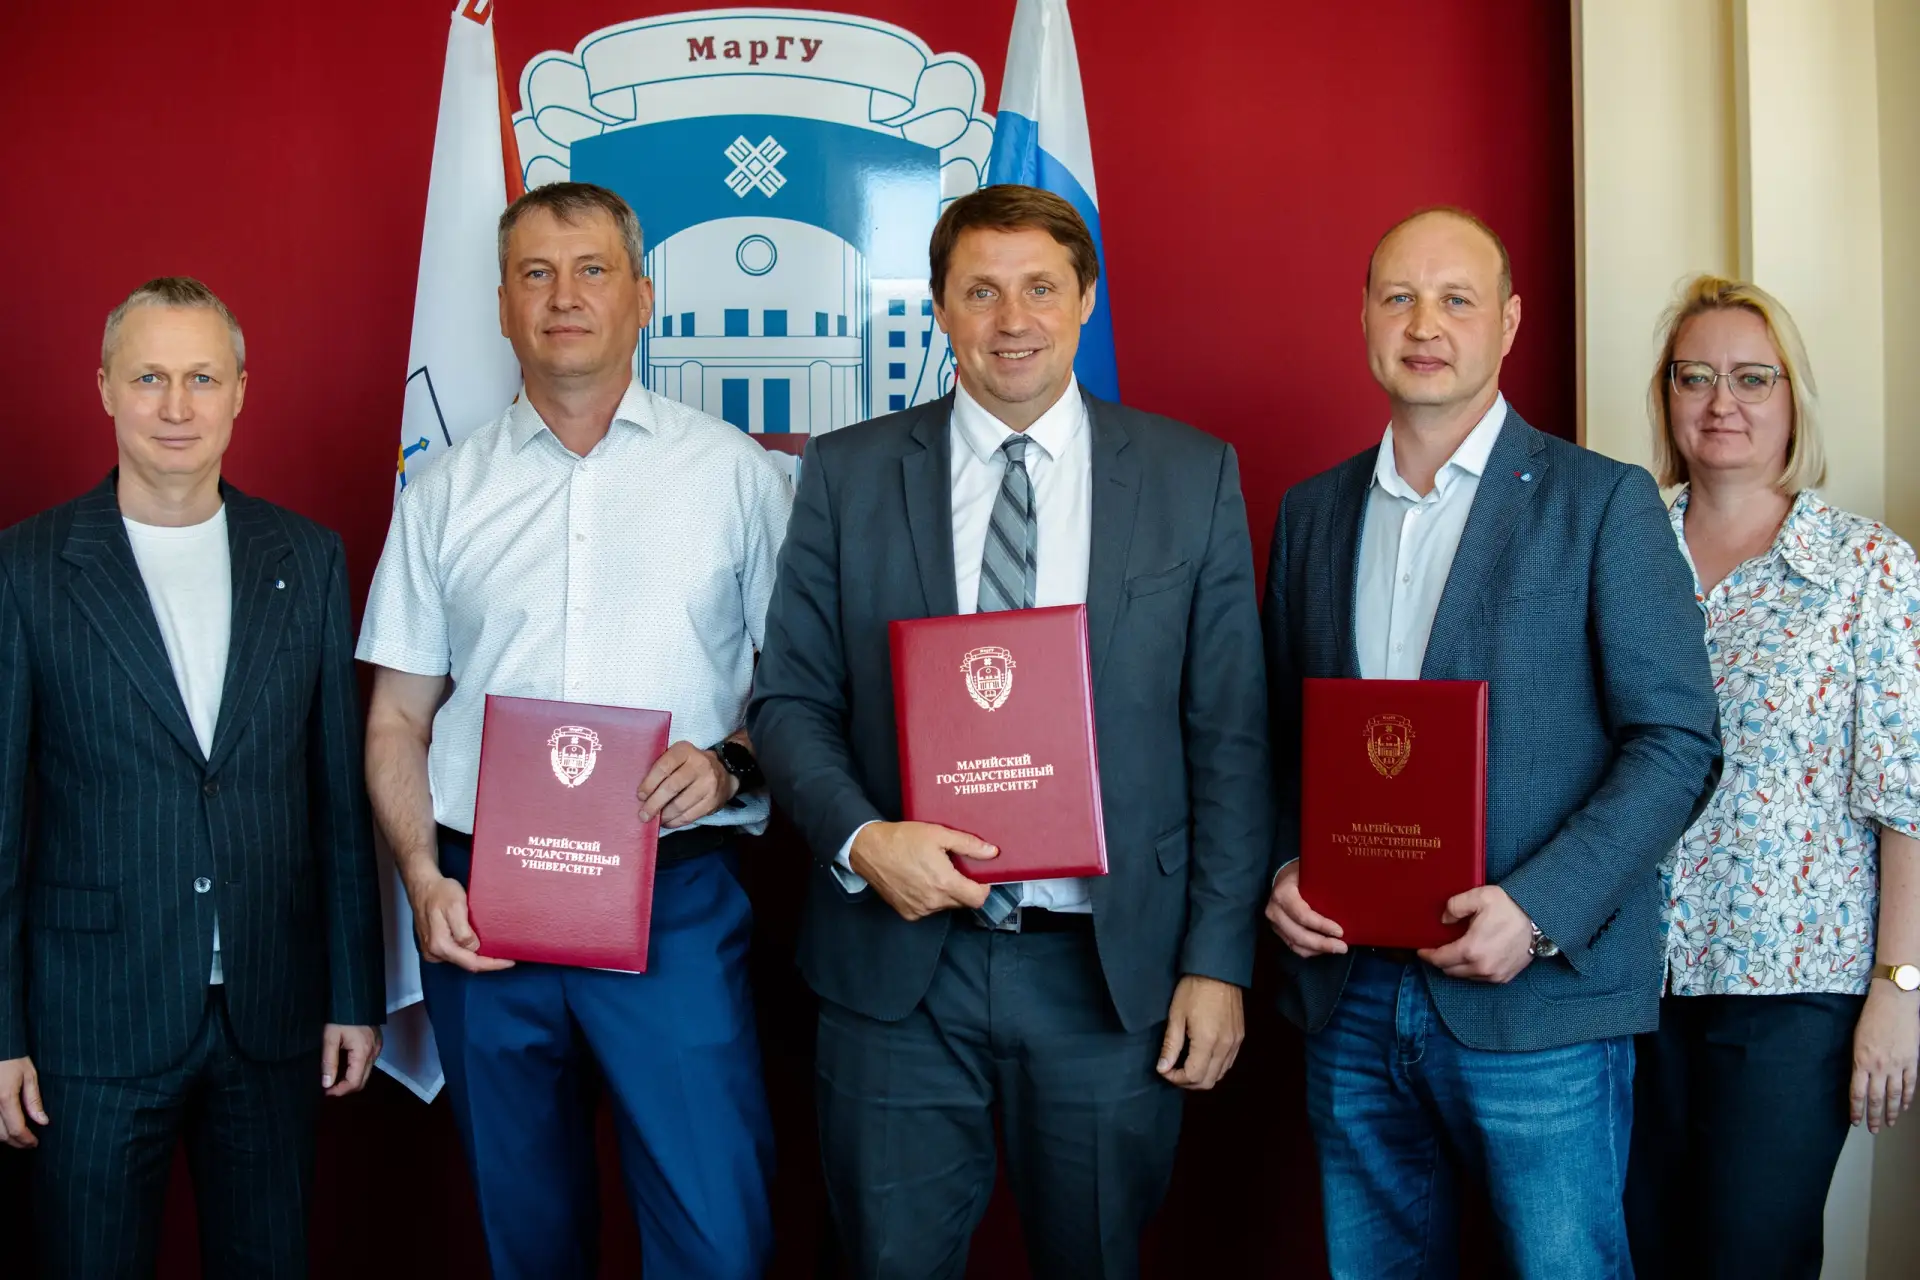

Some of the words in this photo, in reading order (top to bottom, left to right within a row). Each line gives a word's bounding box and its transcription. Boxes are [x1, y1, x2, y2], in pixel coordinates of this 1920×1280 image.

[687, 36, 823, 65] МарГУ
[956, 753, 1032, 771] МАРИЙСКИЙ
[936, 763, 1054, 785] ГОСУДАРСТВЕННЫЙ
[954, 779, 1038, 796] УНИВЕРСИТЕТ
[1352, 822, 1421, 836] МАРИЙСКИЙ
[528, 836, 601, 852] МАРИЙСКИЙ
[1331, 833, 1441, 849] ГОСУДАРСТВЕННЫЙ
[506, 845, 620, 866] ГОСУДАРСТВЕННЫЙ
[1346, 846, 1426, 860] УНИВЕРСИТЕТ
[521, 859, 603, 876] УНИВЕРСИТЕТ
